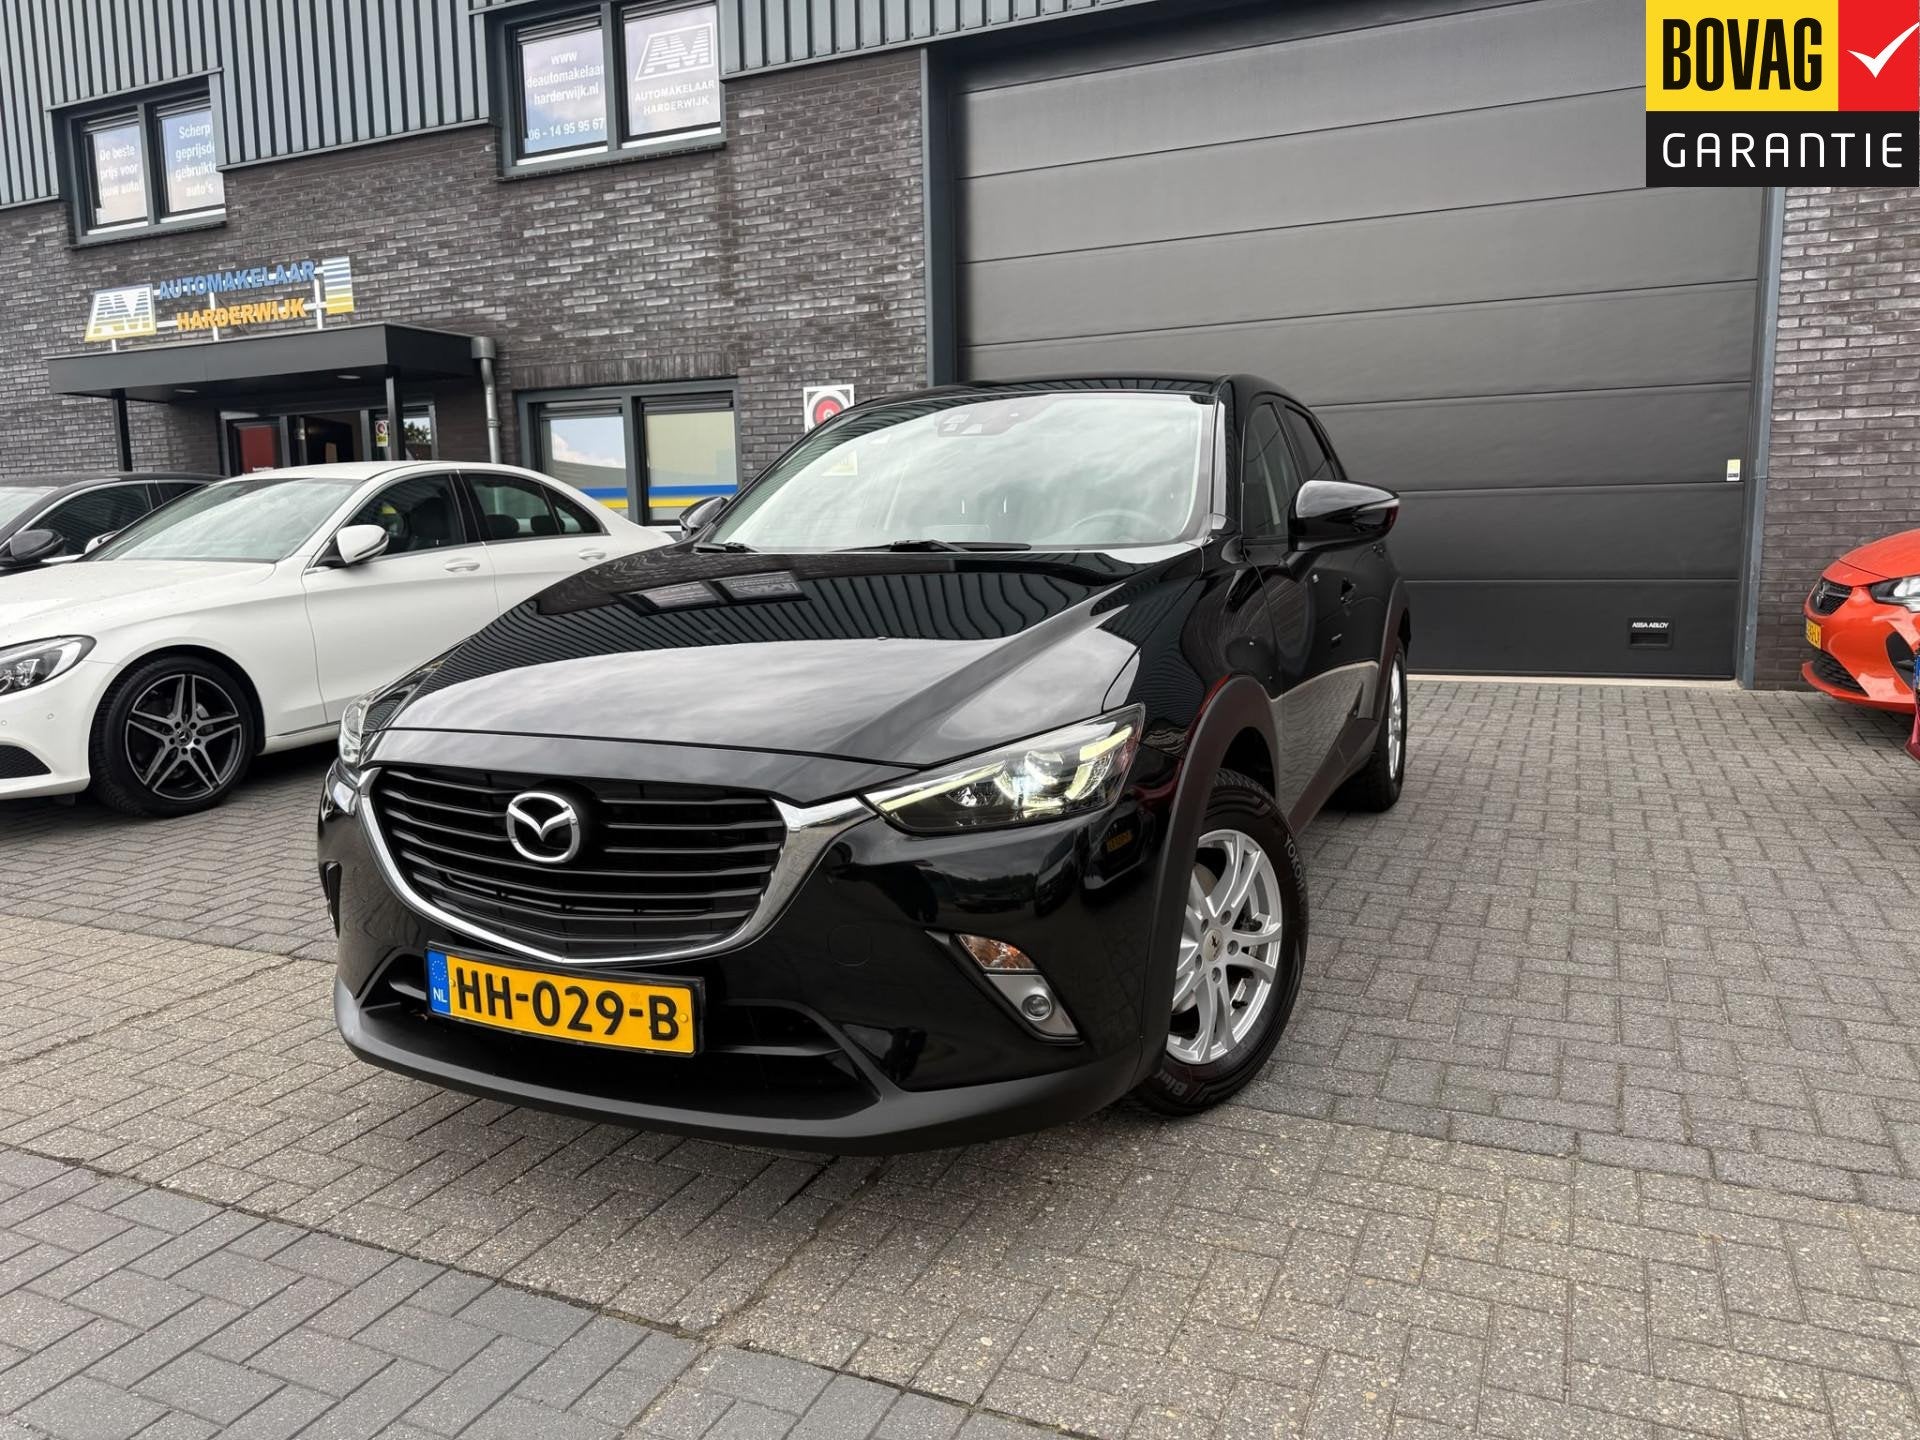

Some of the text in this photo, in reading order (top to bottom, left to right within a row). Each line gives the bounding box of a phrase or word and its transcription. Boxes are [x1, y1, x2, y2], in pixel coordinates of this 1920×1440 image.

[550, 51, 578, 65] www
[526, 64, 605, 88] deautomakelaar
[533, 81, 600, 106] harderwijk.nl
[634, 79, 715, 102] AUTOMAKELAAR
[642, 95, 711, 116] HARDERWIJK
[178, 123, 211, 139] Scherp
[550, 124, 562, 137] 14
[563, 121, 576, 135] 95
[577, 119, 590, 132] 95
[591, 116, 606, 130] 67
[158, 260, 316, 301] AUTOMAKELAAR
[176, 297, 307, 331] HARDERWIJK
[432, 966, 680, 1042] NL HH-029-B
